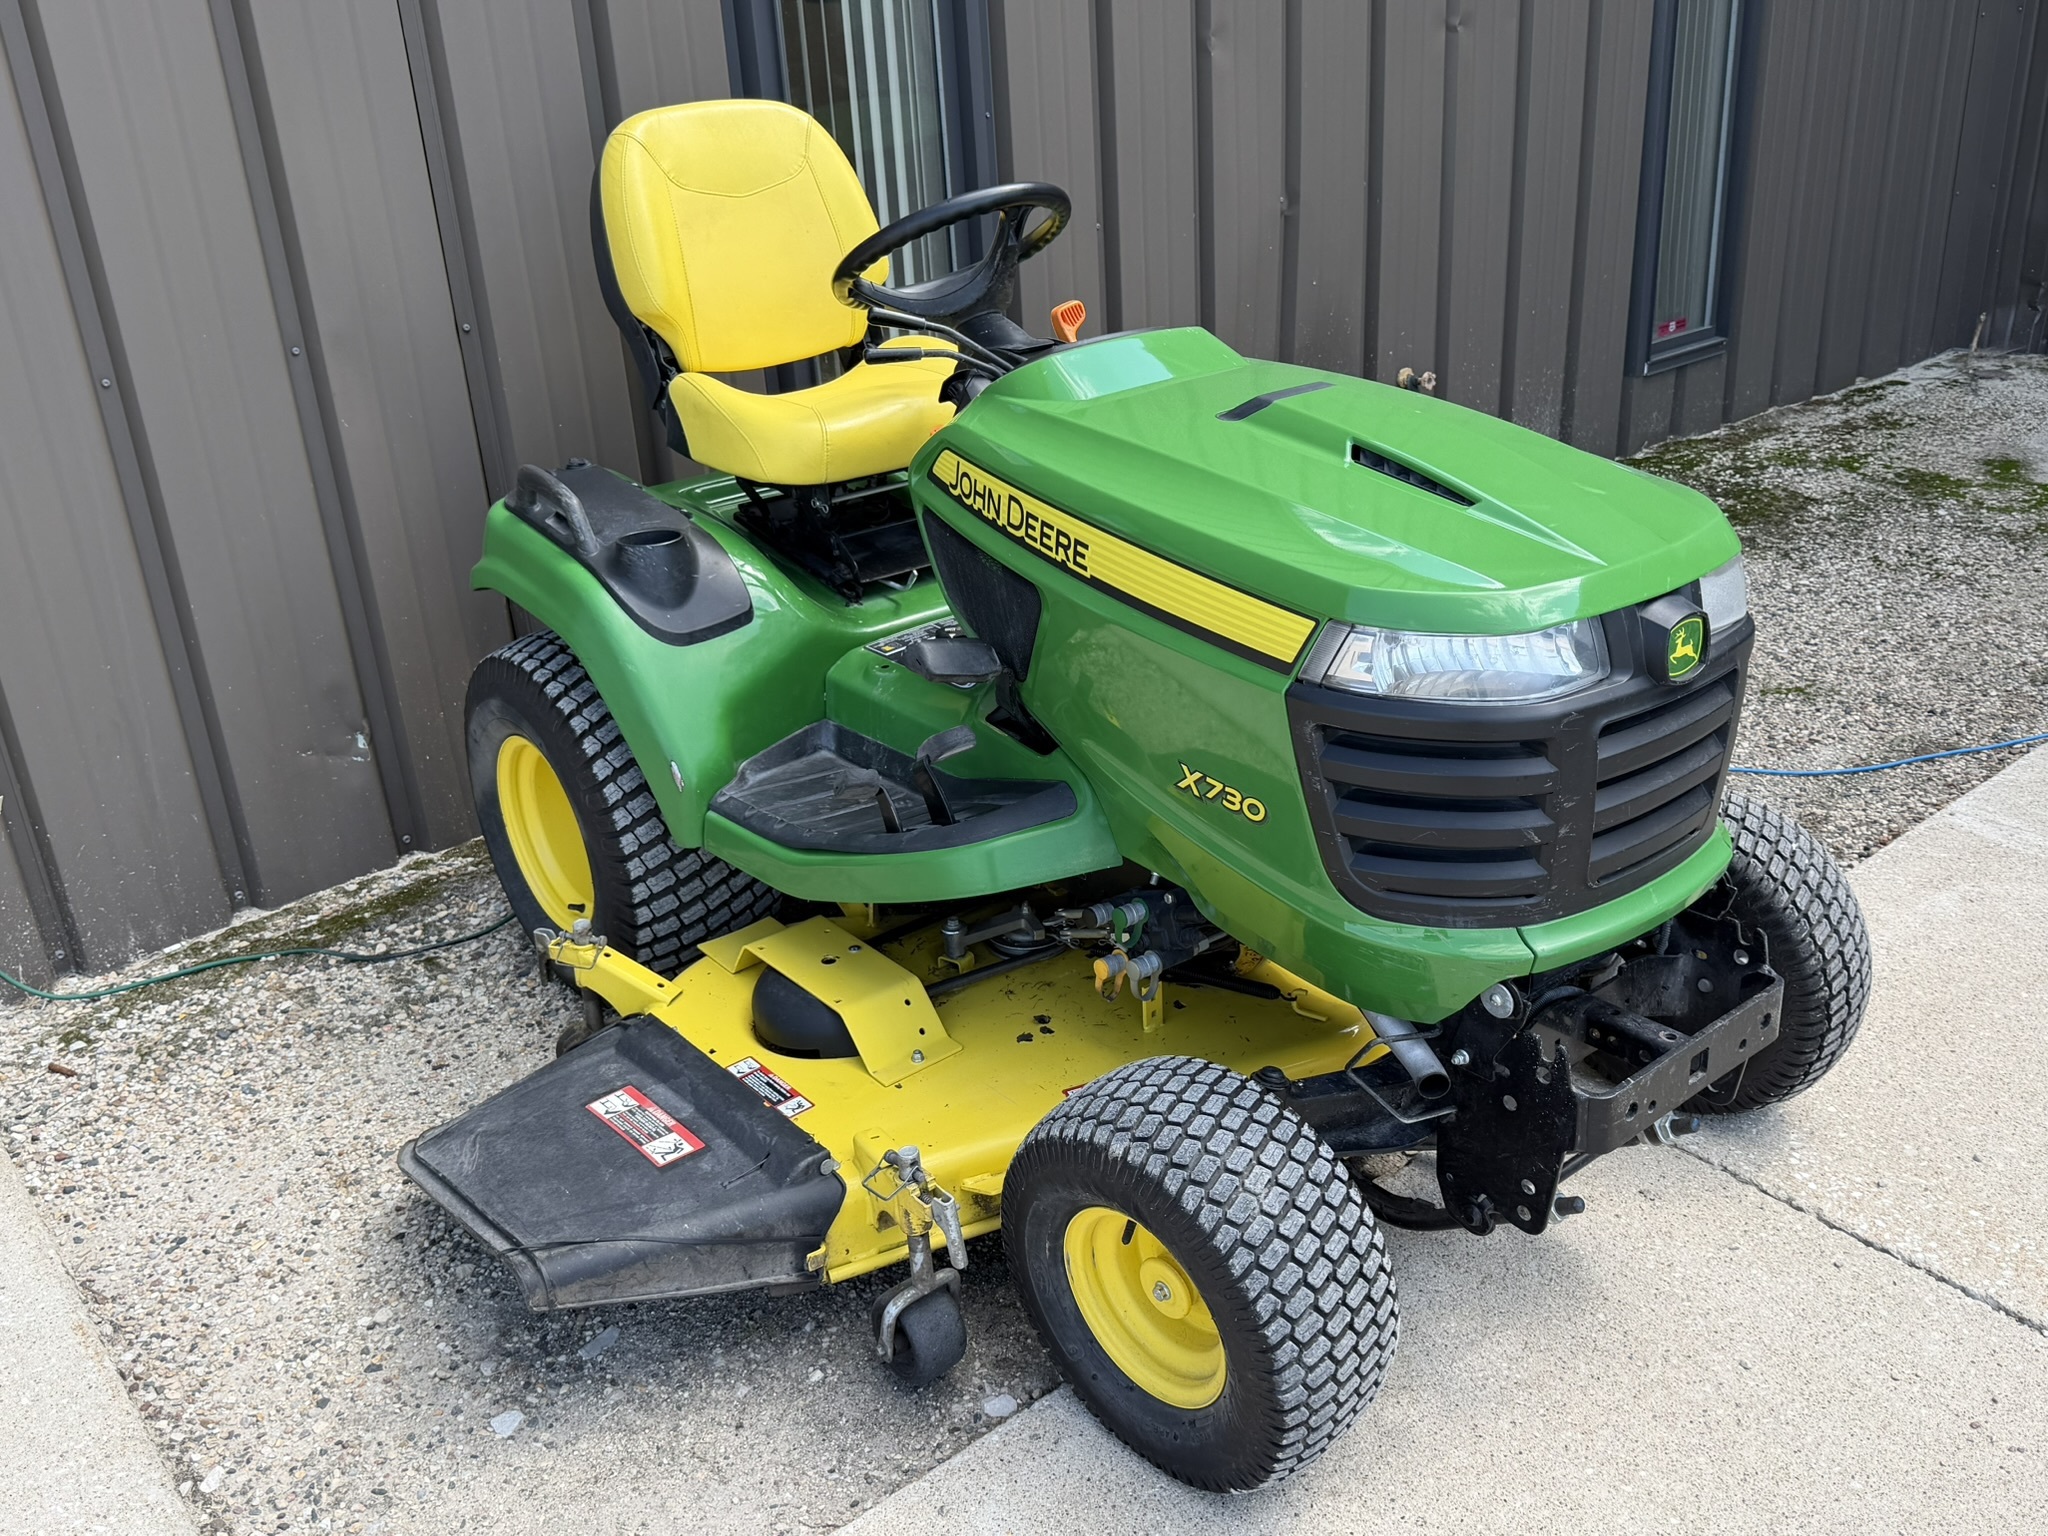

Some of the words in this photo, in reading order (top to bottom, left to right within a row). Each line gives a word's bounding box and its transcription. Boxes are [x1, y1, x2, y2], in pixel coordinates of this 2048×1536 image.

[948, 459, 1003, 522] JOHN
[1006, 492, 1091, 574] DEERE
[1174, 760, 1267, 823] X730
